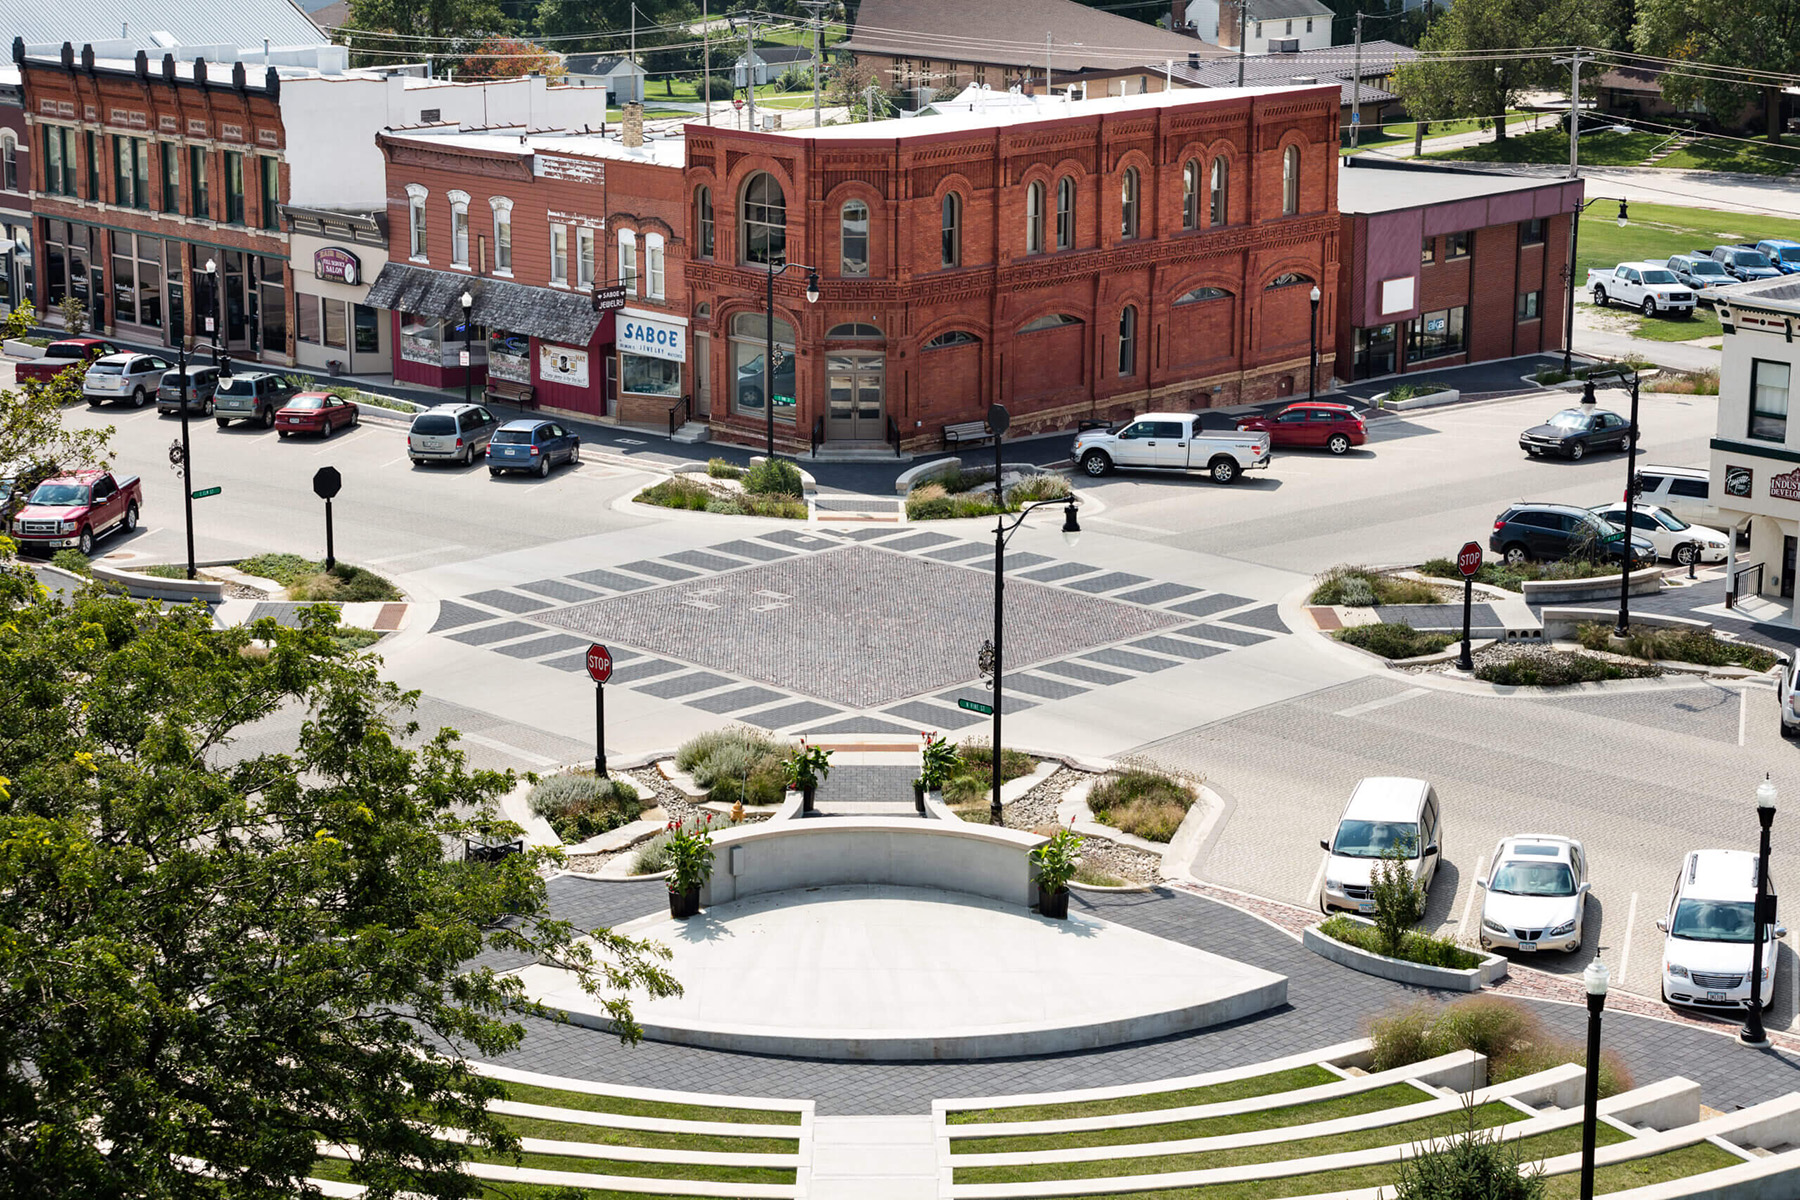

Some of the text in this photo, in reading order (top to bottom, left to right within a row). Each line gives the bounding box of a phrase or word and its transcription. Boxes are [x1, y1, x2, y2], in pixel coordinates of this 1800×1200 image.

[326, 266, 343, 275] SALON
[603, 291, 620, 299] SABOE
[599, 299, 624, 310] JEWELRY
[1428, 320, 1444, 331] aka
[624, 323, 678, 347] SABOE
[639, 345, 664, 355] JEWELRY
[1461, 552, 1480, 567] STOP
[589, 655, 610, 671] STOP
